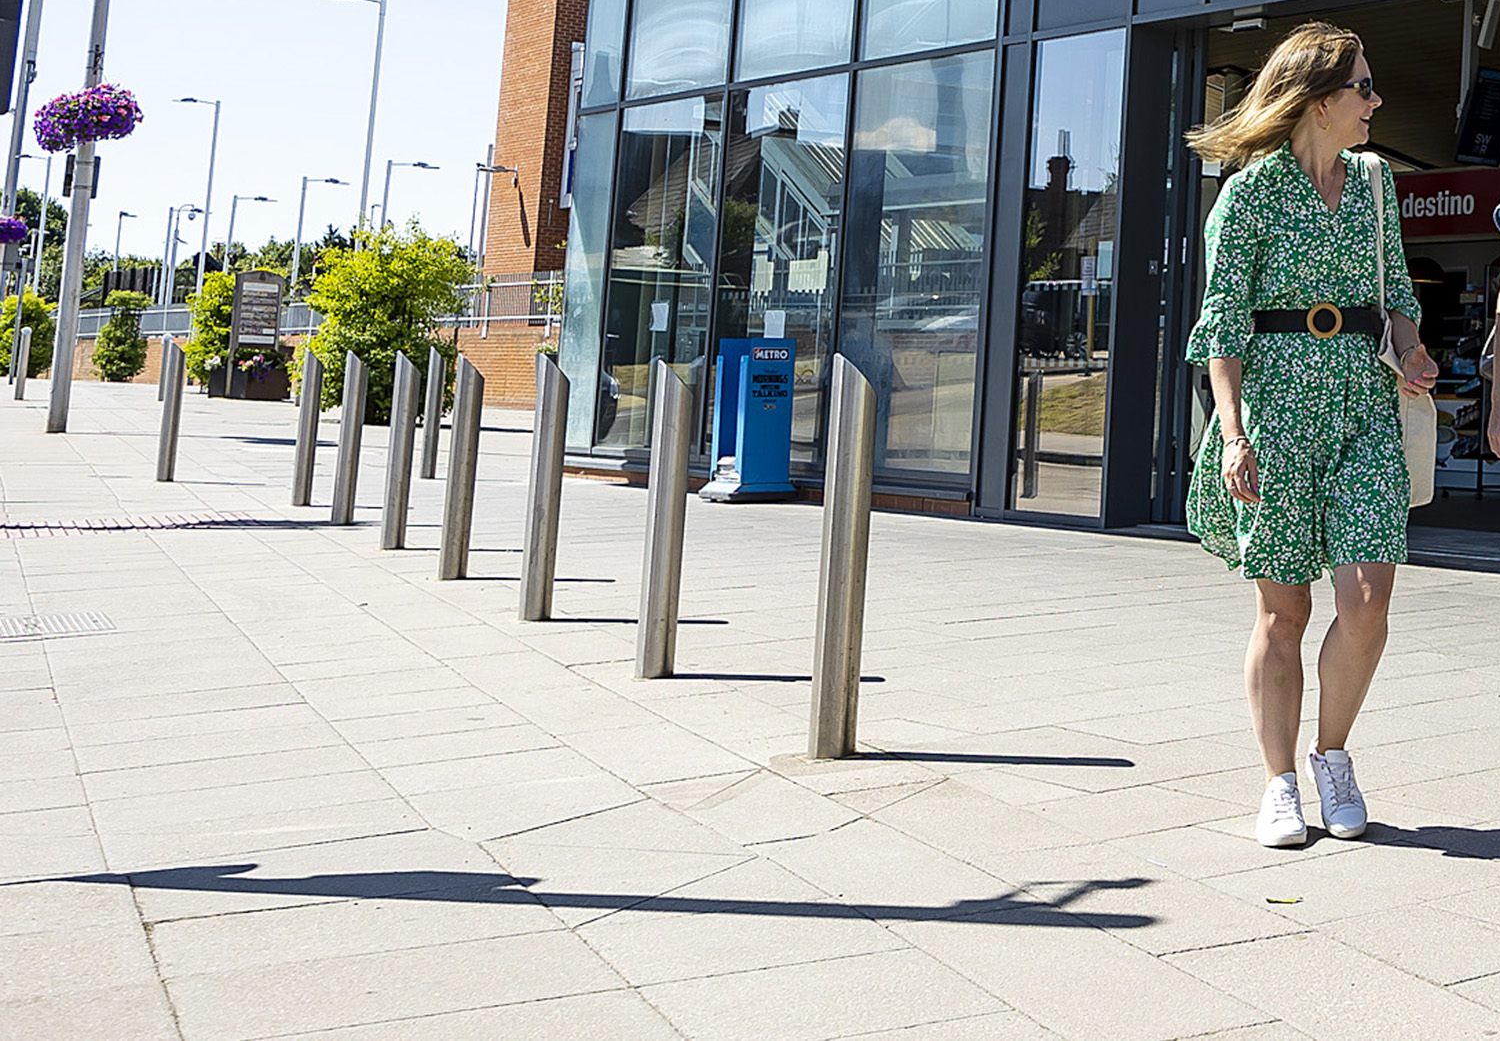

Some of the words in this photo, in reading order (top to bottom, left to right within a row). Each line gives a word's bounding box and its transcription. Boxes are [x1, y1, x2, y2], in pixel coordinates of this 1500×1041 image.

[1474, 133, 1492, 145] SW
[1402, 190, 1475, 218] destino
[756, 349, 788, 360] METRO
[752, 390, 788, 398] TALKING
